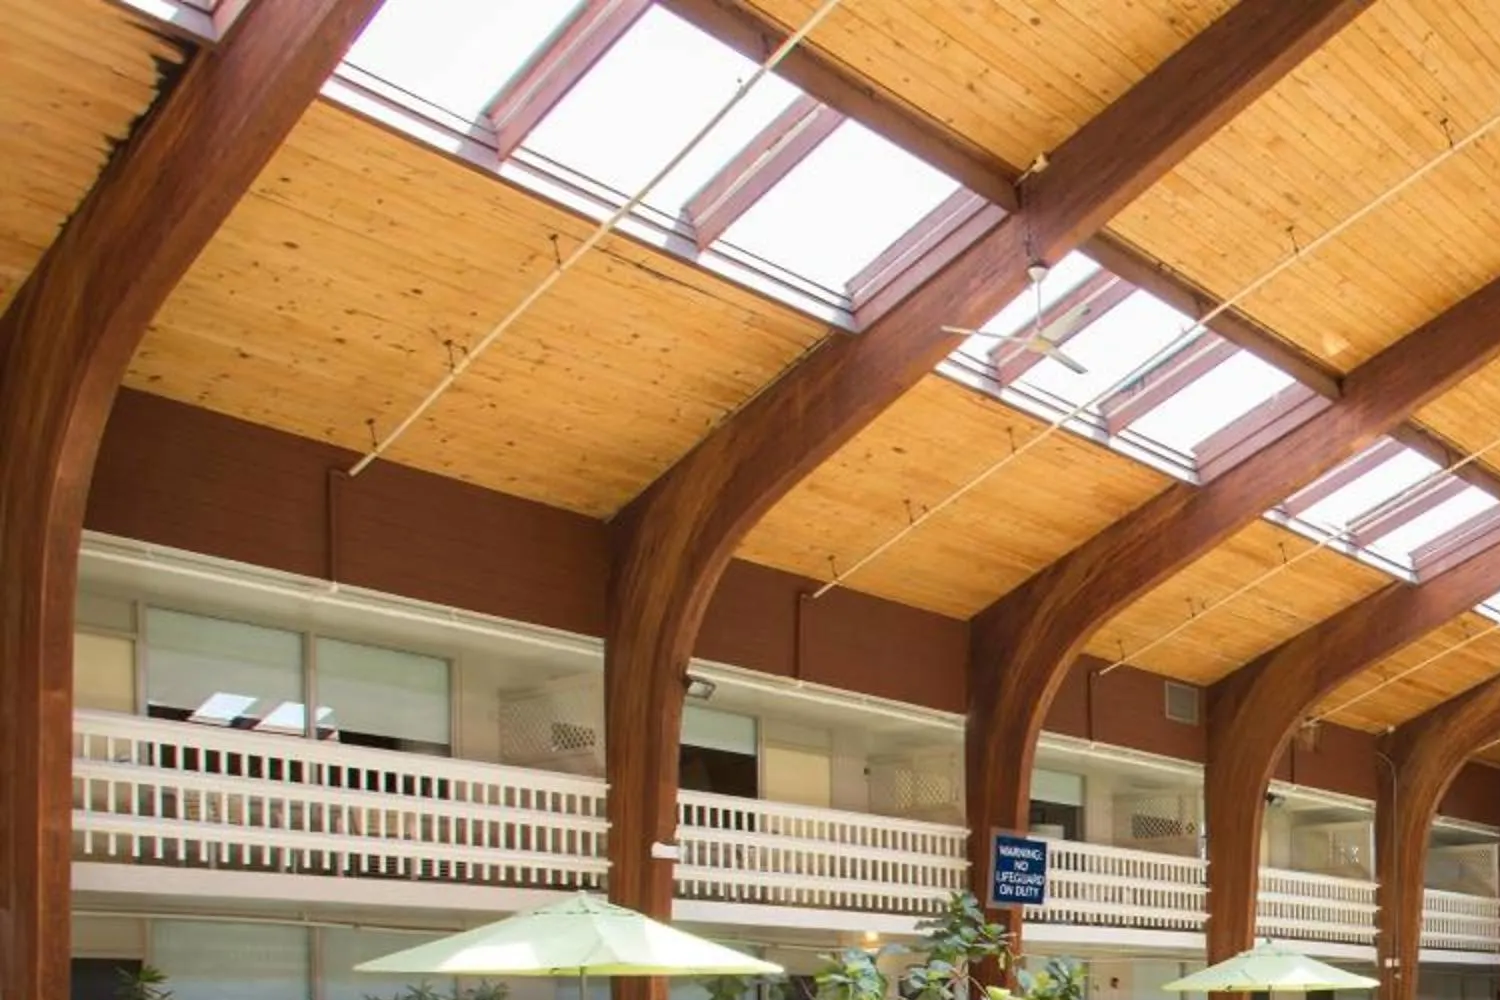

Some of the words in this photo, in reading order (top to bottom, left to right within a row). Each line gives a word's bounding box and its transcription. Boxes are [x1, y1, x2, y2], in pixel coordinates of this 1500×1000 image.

[1014, 861, 1029, 871] NO
[996, 871, 1045, 886] LIFEGUARD
[1000, 884, 1013, 895] ON
[1015, 885, 1039, 896] DUTY
